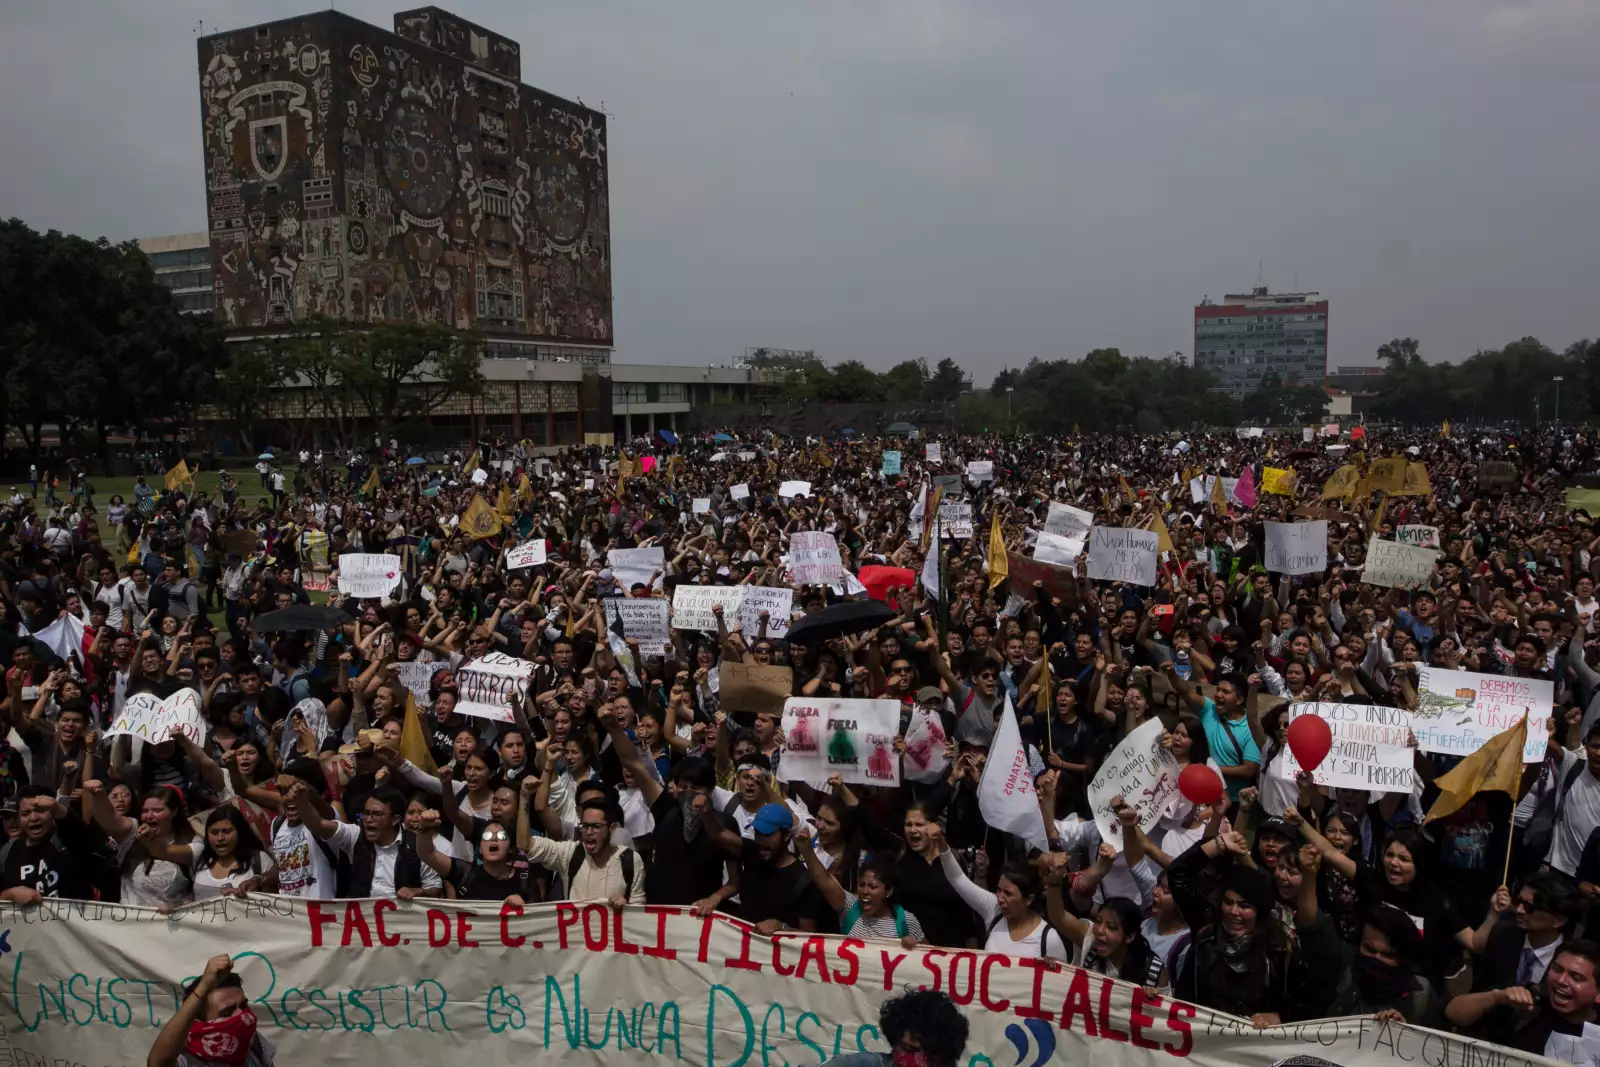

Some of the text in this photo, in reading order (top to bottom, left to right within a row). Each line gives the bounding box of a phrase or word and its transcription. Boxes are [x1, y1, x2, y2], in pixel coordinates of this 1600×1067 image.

[1115, 549, 1128, 563] ME
[1375, 541, 1413, 561] FUERA
[1372, 570, 1388, 584] LA
[676, 587, 692, 596] Ser
[719, 588, 728, 596] no
[674, 619, 693, 628] hasta
[481, 653, 539, 672] UERA
[458, 670, 525, 706] PORROS
[1479, 679, 1530, 696] DEBEMOS
[789, 706, 820, 718] FUERA
[1289, 702, 1410, 728] TODOS UNIDOS
[1477, 702, 1501, 713] A LA
[827, 718, 859, 731] FUERA
[1121, 746, 1135, 760] tu
[1091, 777, 1105, 793] No
[1106, 764, 1118, 780] es
[1119, 753, 1146, 780] amigo
[1329, 757, 1338, 772] Y
[1341, 760, 1365, 777] SIN
[1367, 764, 1414, 788] PORROS
[245, 896, 296, 919] ARQ
[306, 899, 1197, 1059] FAC. DE C. POLITICAS Y SOCIALES
[11, 951, 198, 1034] INSISTI
[231, 950, 454, 1034] RESISTIR
[543, 973, 682, 1061] NUNCA
[706, 983, 880, 1067] DESIS
[1358, 1017, 1415, 1062] FAC
